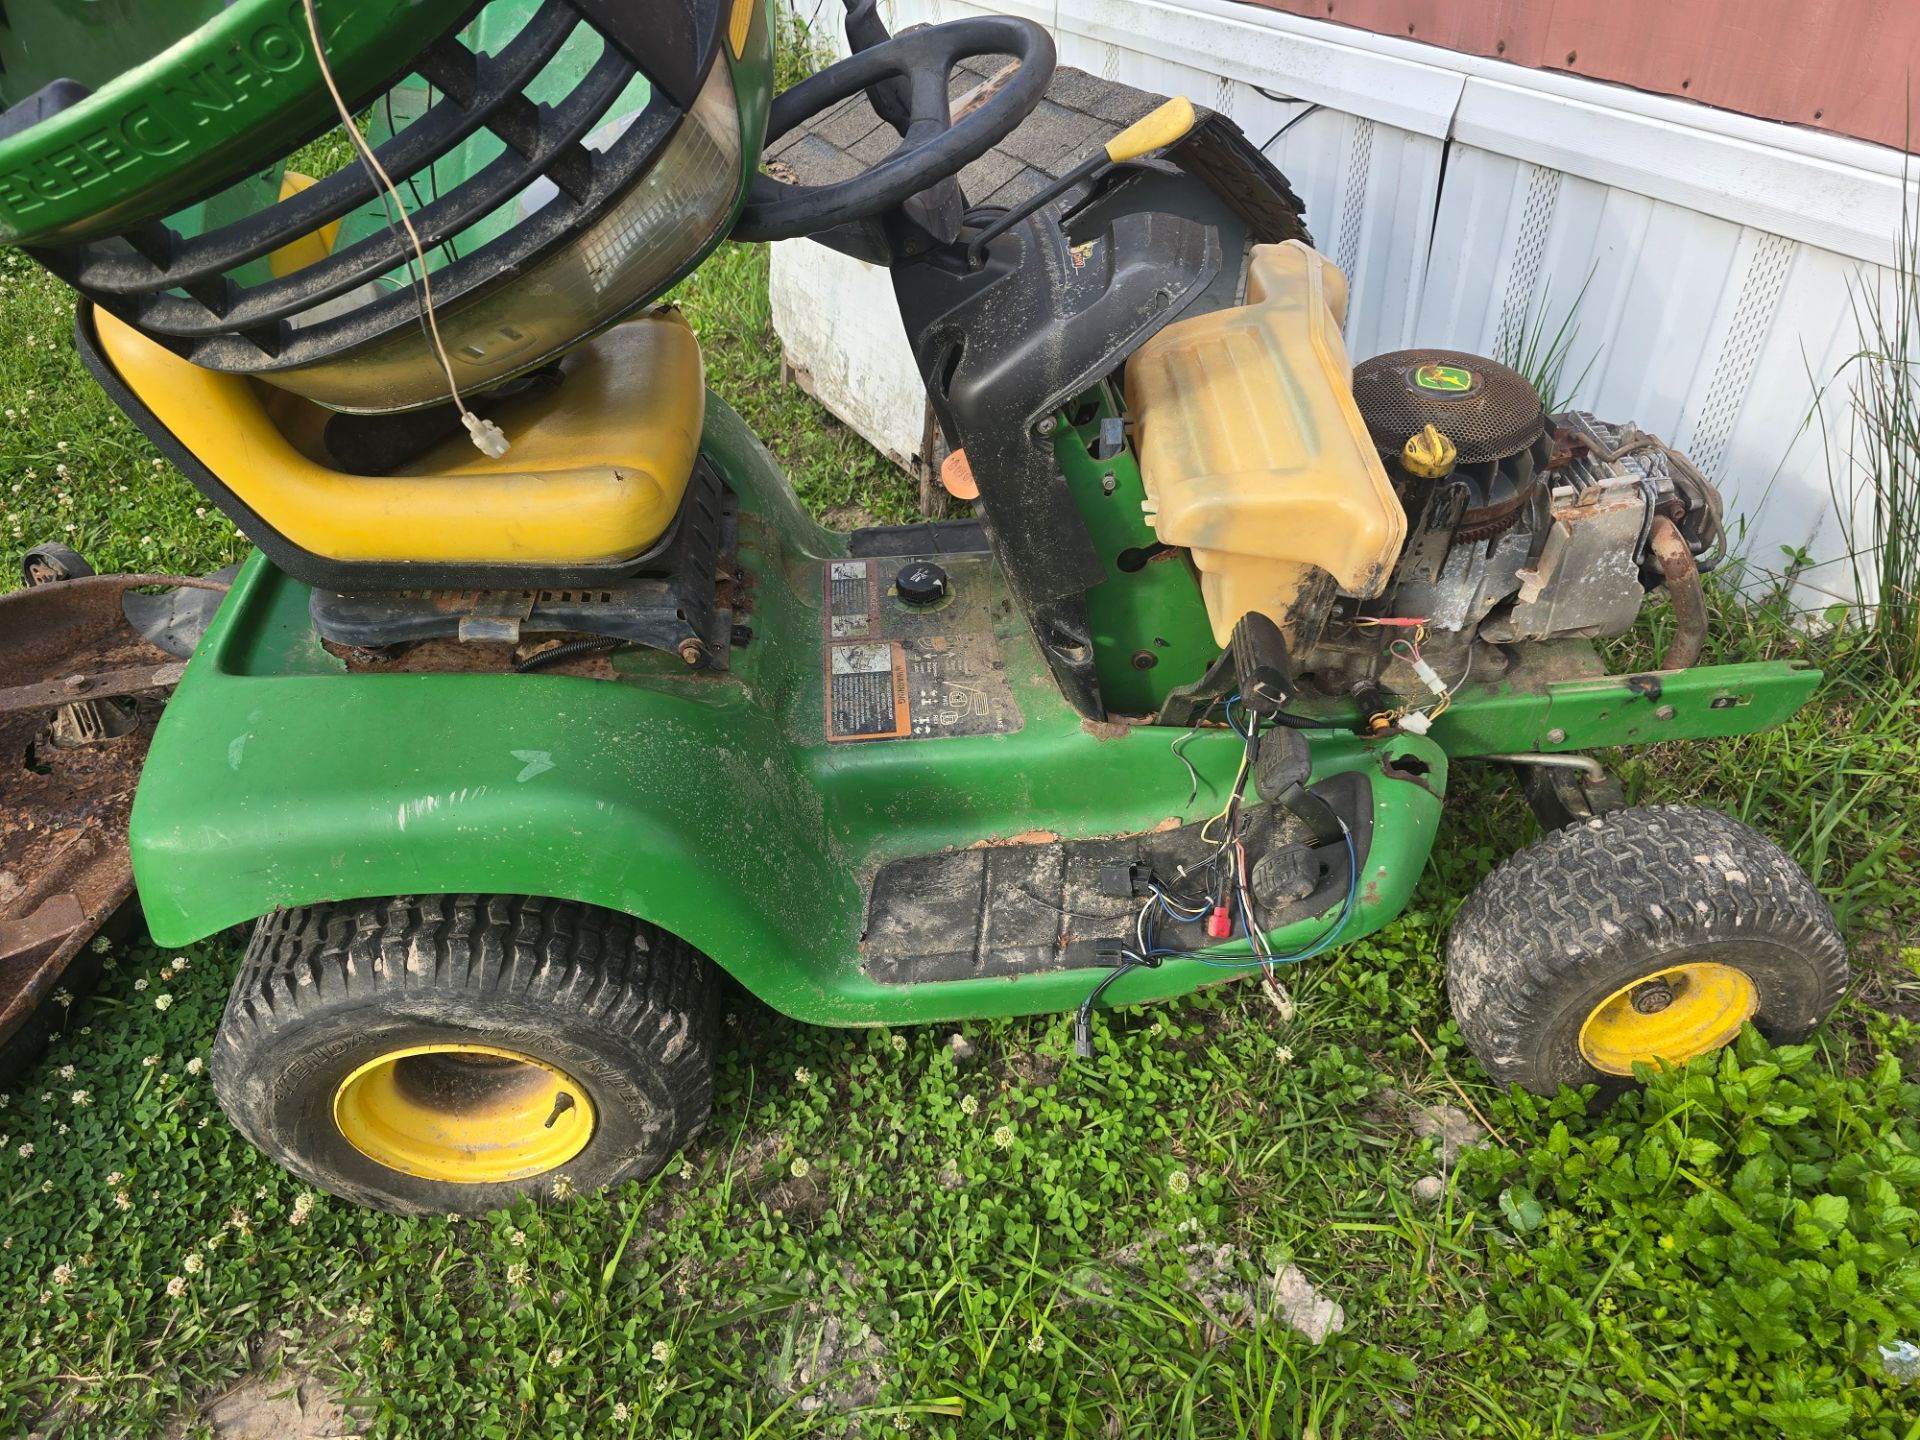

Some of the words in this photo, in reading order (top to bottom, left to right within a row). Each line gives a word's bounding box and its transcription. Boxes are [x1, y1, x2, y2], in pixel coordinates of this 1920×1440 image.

[0, 103, 191, 214] DEERE
[895, 671, 906, 704] WARNING
[274, 1029, 376, 1096] KENDA
